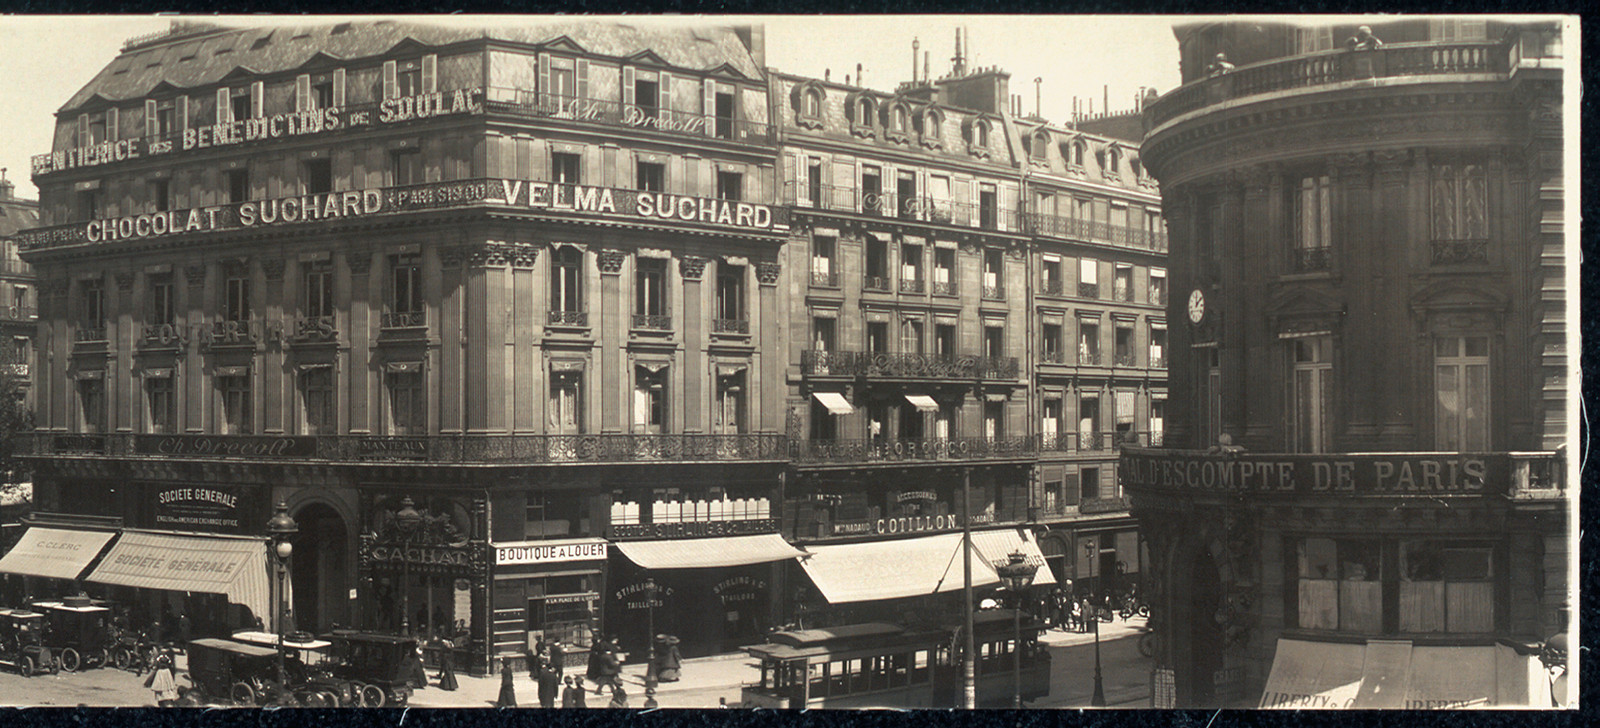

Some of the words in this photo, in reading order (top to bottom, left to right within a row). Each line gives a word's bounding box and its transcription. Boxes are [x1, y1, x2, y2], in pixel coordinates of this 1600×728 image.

[31, 137, 140, 175] DENTIFRICE
[183, 107, 339, 150] BENEDICTINS
[350, 112, 369, 126] DE
[379, 88, 484, 123] SOULAC
[502, 179, 616, 212] VELMA
[636, 192, 771, 228] SUCHARD
[86, 207, 221, 242] CHOCOLAT
[239, 188, 382, 225] SUCHARD
[194, 437, 296, 456] Drecoll
[1149, 459, 1296, 491] D'ESCOMPTE
[1312, 461, 1355, 491] DE
[1373, 460, 1486, 491] PARIS
[223, 519, 238, 527] OFFICE
[877, 514, 956, 534] COTILLON
[371, 547, 468, 566] CACHAT
[499, 546, 556, 561] BOUTIQUE
[558, 548, 566, 558] A
[568, 543, 604, 557] LOUER
[114, 553, 165, 570] SOCIÉTÉ
[167, 556, 237, 575] GÉNÉRALE
[1261, 692, 1331, 707] LIBERTY
